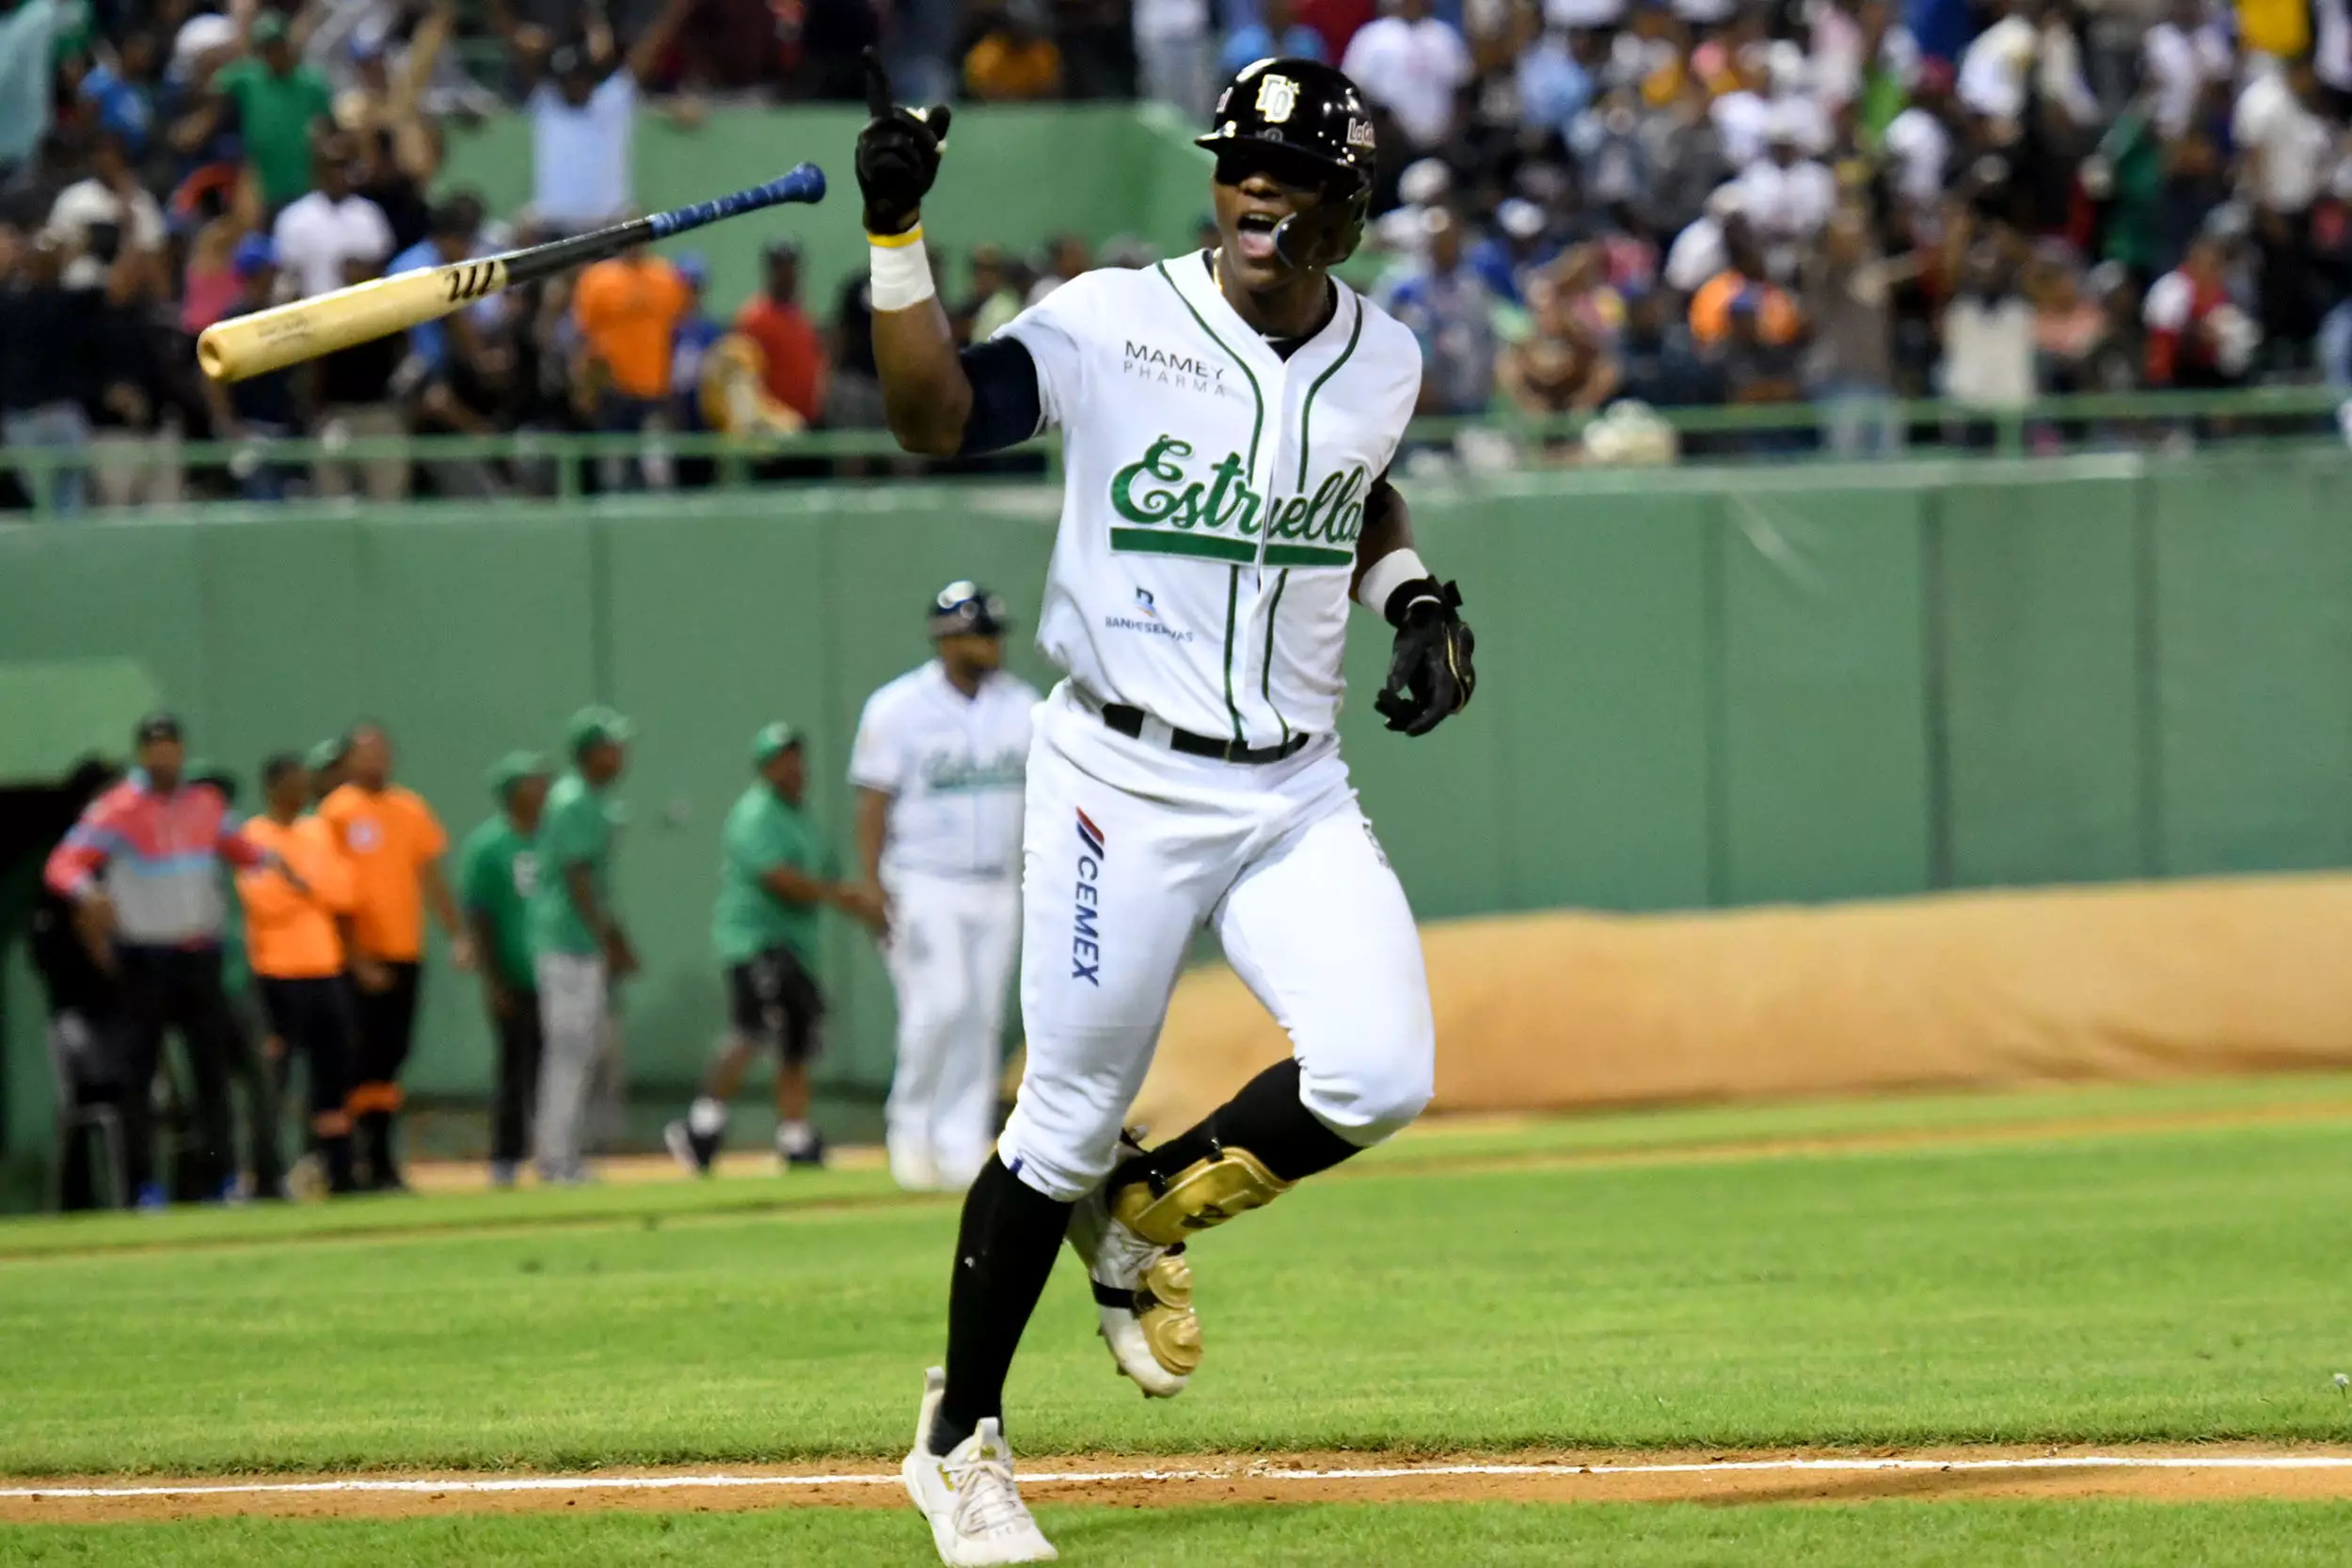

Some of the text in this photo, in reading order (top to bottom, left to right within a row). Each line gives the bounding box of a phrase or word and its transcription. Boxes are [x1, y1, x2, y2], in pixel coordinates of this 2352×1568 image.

[1123, 361, 1226, 398] PHARMA
[1125, 341, 1225, 380] MAMEY
[1110, 434, 1362, 545] Estrella
[1072, 856, 1100, 987] CEMEX
